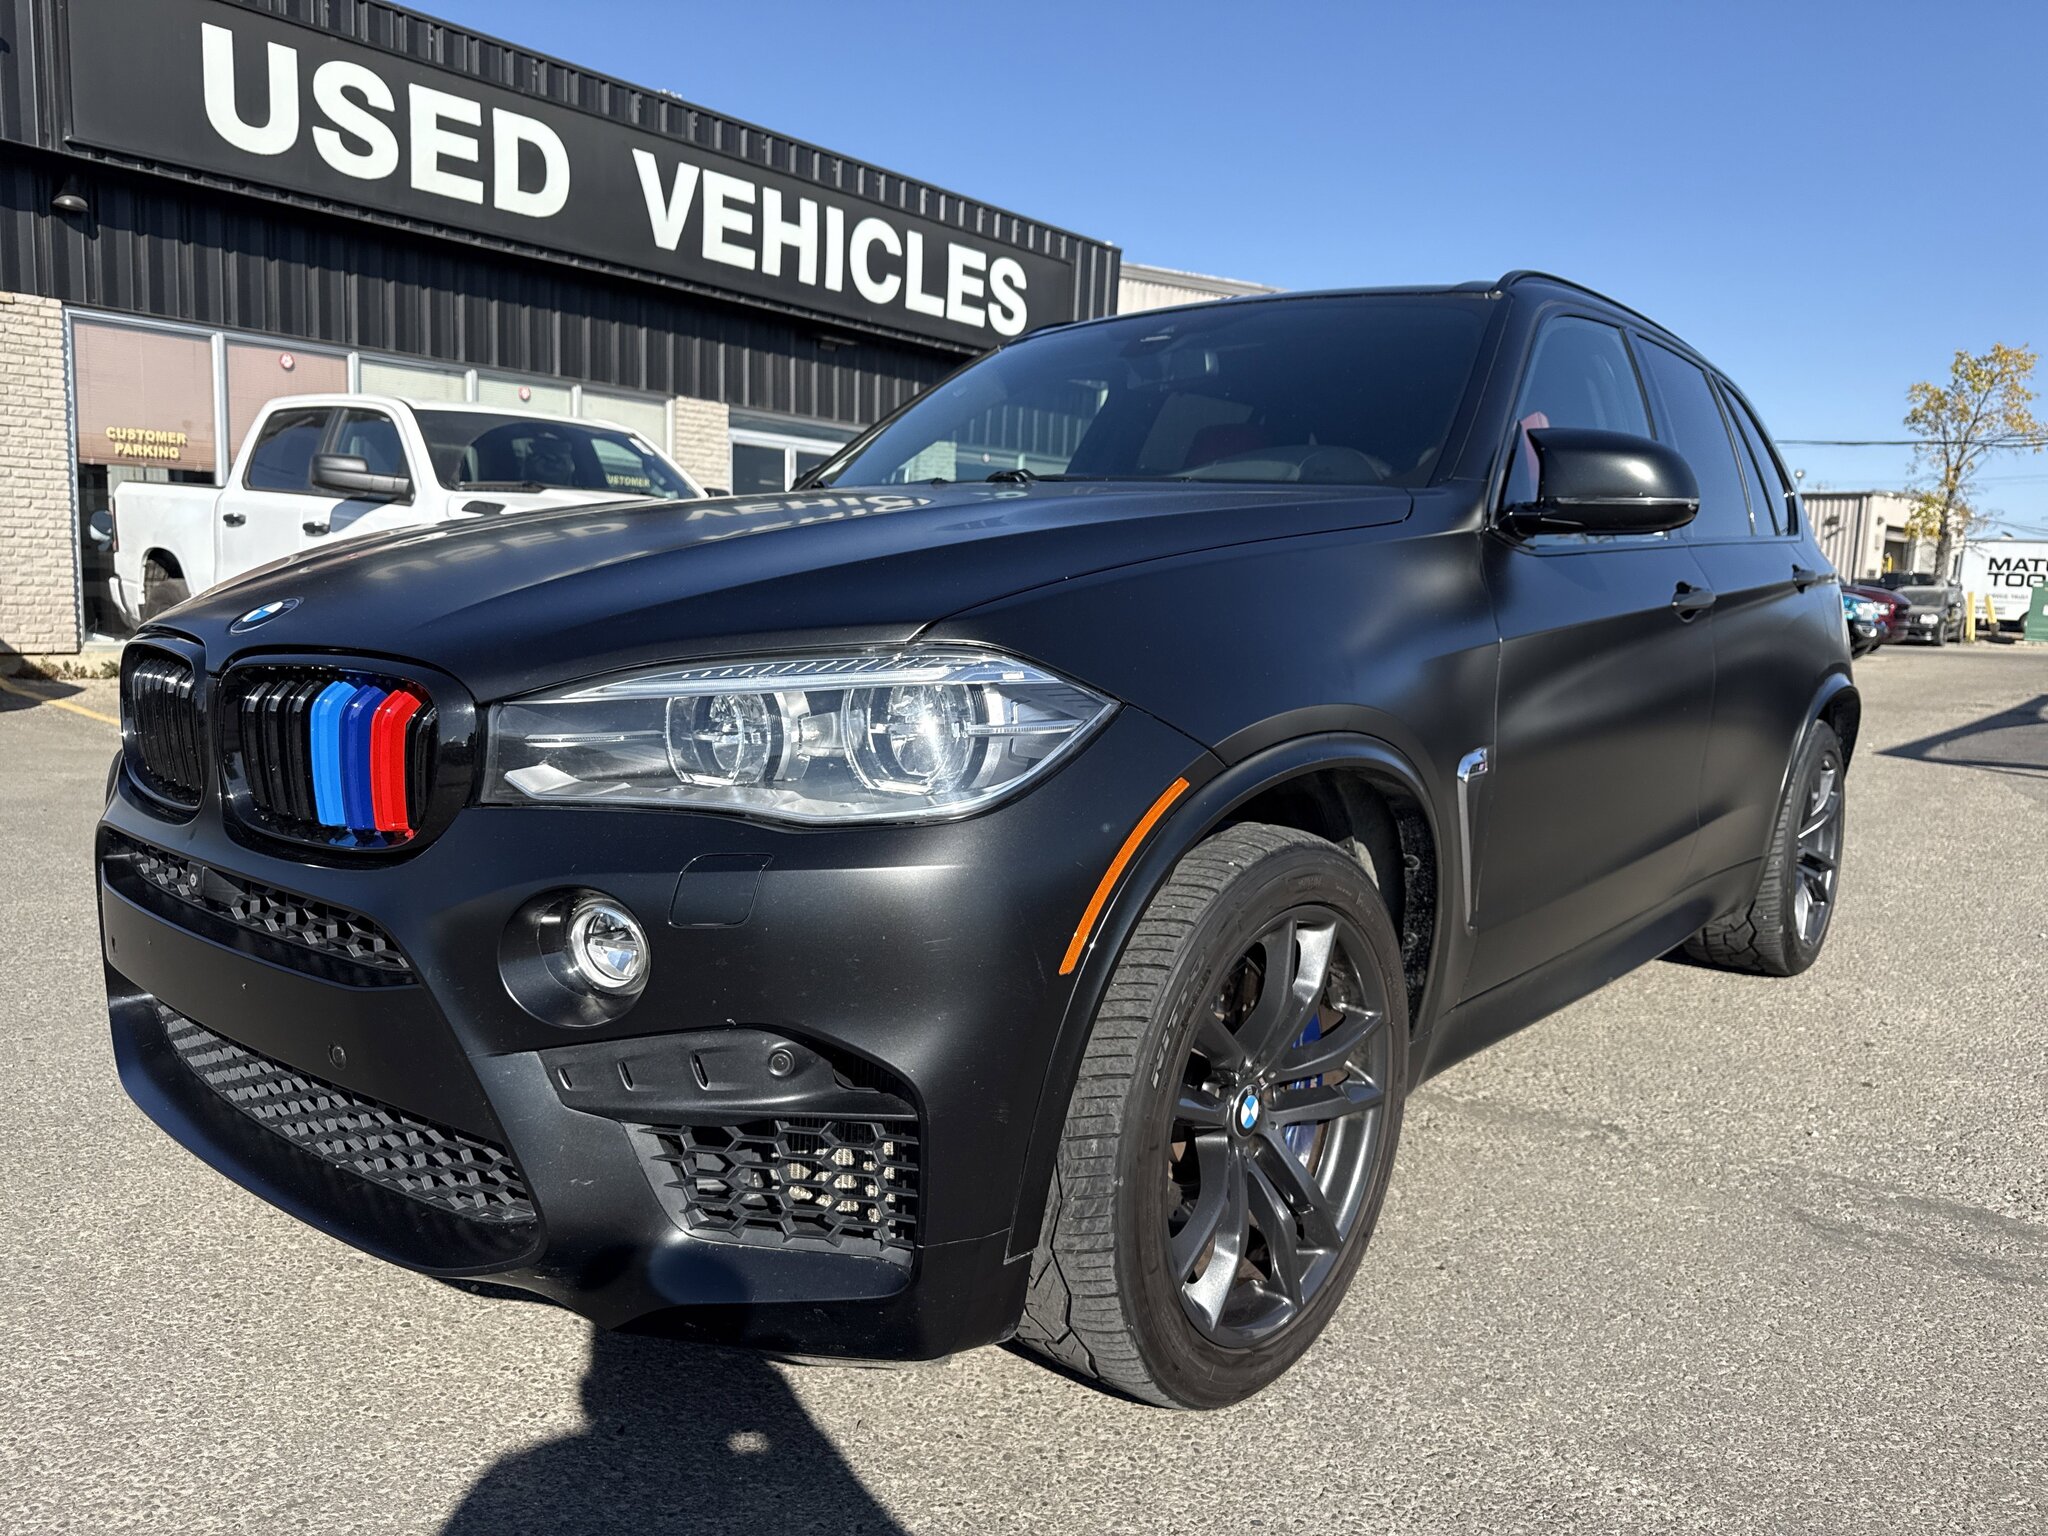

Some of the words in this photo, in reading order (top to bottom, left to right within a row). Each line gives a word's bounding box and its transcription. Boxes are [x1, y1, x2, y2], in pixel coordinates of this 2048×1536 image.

[202, 23, 570, 218] USED
[632, 148, 1028, 336] VEHICLES
[105, 426, 187, 446] CUSTOMER
[114, 442, 180, 460] PARKING
[605, 472, 651, 488] USTOMER
[1988, 557, 2048, 572] MAT
[1151, 953, 1205, 1089] NITTO
